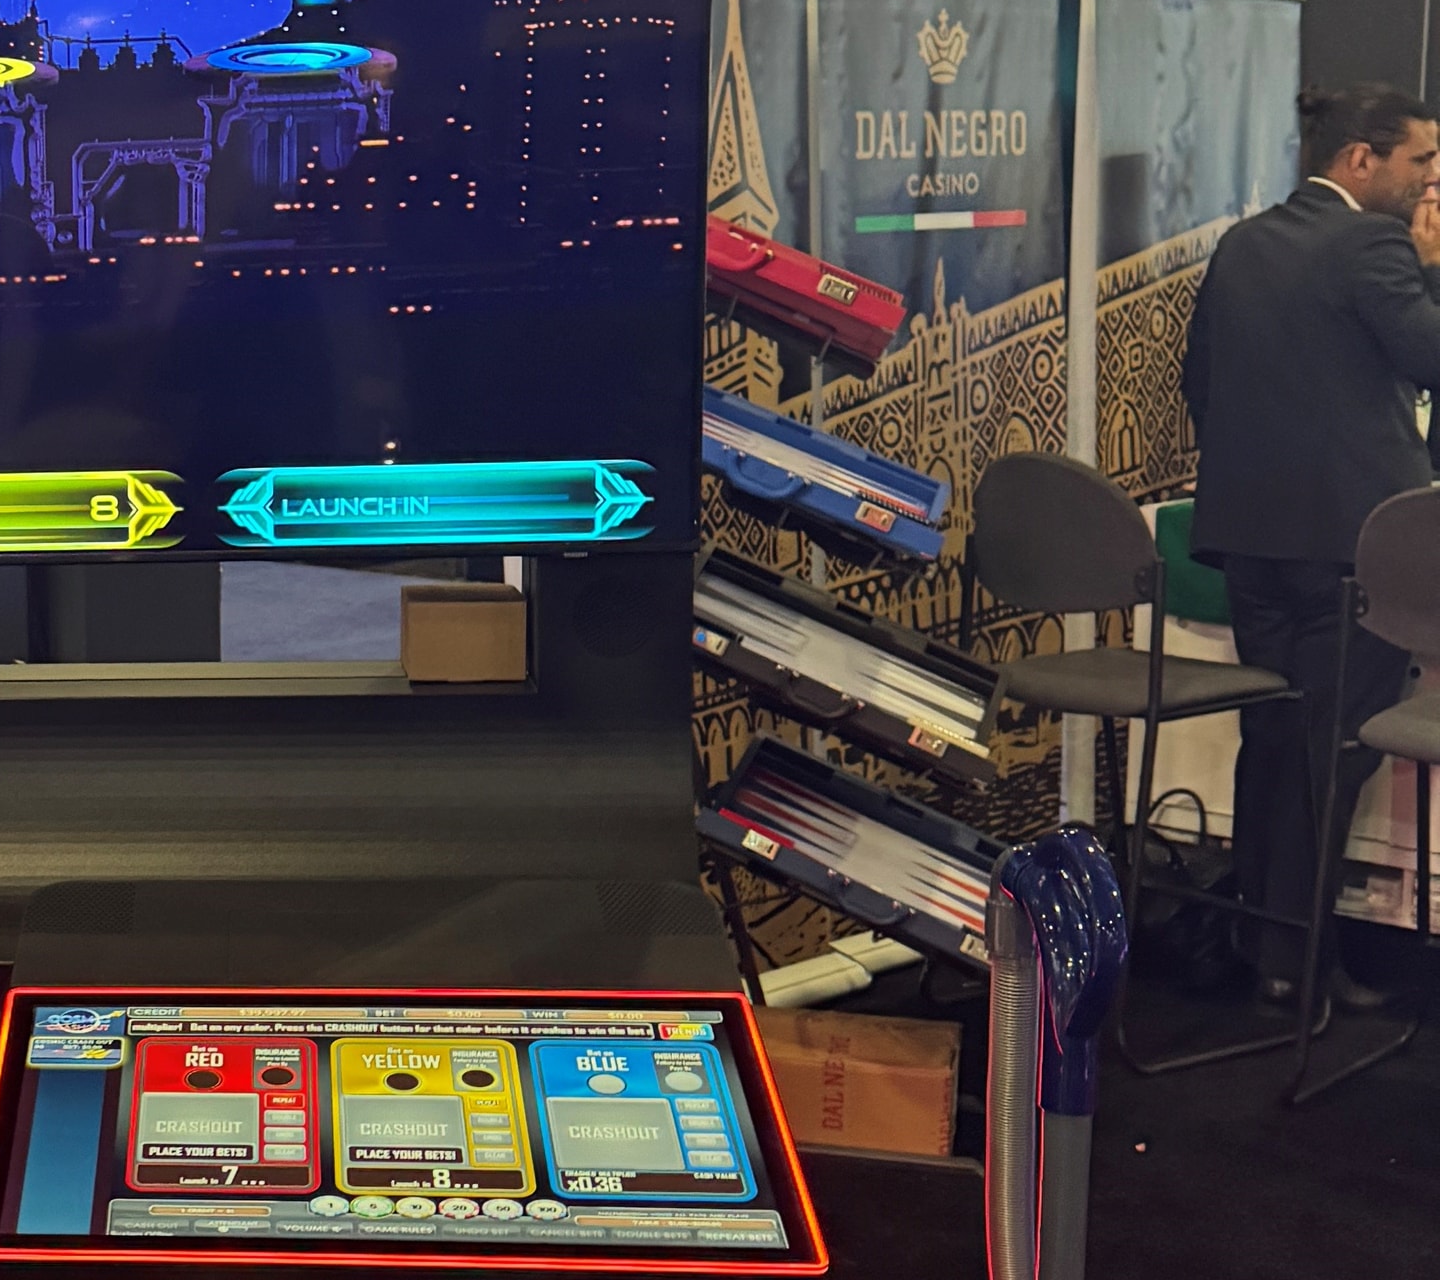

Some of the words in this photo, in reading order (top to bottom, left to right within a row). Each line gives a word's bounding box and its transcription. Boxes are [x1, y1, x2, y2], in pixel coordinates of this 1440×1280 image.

[856, 111, 916, 160] DAL
[924, 110, 1027, 159] NEGRO
[906, 172, 979, 198] CASINO
[89, 494, 119, 521] 8
[282, 497, 401, 517] LAUNCH
[403, 496, 430, 516] IN
[190, 1023, 208, 1032] Bet
[209, 1024, 223, 1032] on
[224, 1024, 242, 1033] any
[244, 1023, 273, 1032] color.
[274, 1023, 304, 1032] Press
[306, 1024, 323, 1032] the
[325, 1023, 379, 1032] CRASHOUT
[380, 1024, 413, 1033] button
[415, 1024, 431, 1033] for
[433, 1025, 454, 1033] that
[455, 1025, 483, 1033] color
[485, 1025, 519, 1034] before
[531, 1026, 573, 1035] crashes
[574, 1027, 587, 1035] to
[588, 1027, 606, 1035] win
[608, 1027, 626, 1035] the
[626, 1027, 645, 1036] bet
[666, 1027, 707, 1036] TRENDS
[185, 1052, 224, 1067] RED
[587, 1049, 602, 1057] Bet
[362, 1054, 441, 1069] YELLOW
[576, 1056, 630, 1071] BLUE
[155, 1121, 243, 1133] CRASHOUT
[360, 1123, 448, 1136] CRASHOUT
[569, 1126, 659, 1139] CRASHOUT
[149, 1147, 183, 1156] PLACE
[185, 1147, 214, 1156] YOUR
[215, 1147, 247, 1157] BETS!
[356, 1149, 391, 1159] PLACE
[392, 1150, 423, 1160] YOUR
[425, 1150, 456, 1160] BETS!
[179, 1177, 209, 1185] Launch
[567, 1177, 623, 1192] x0.36
[705, 1232, 746, 1240] REPEAT
[749, 1233, 774, 1241] BETS
